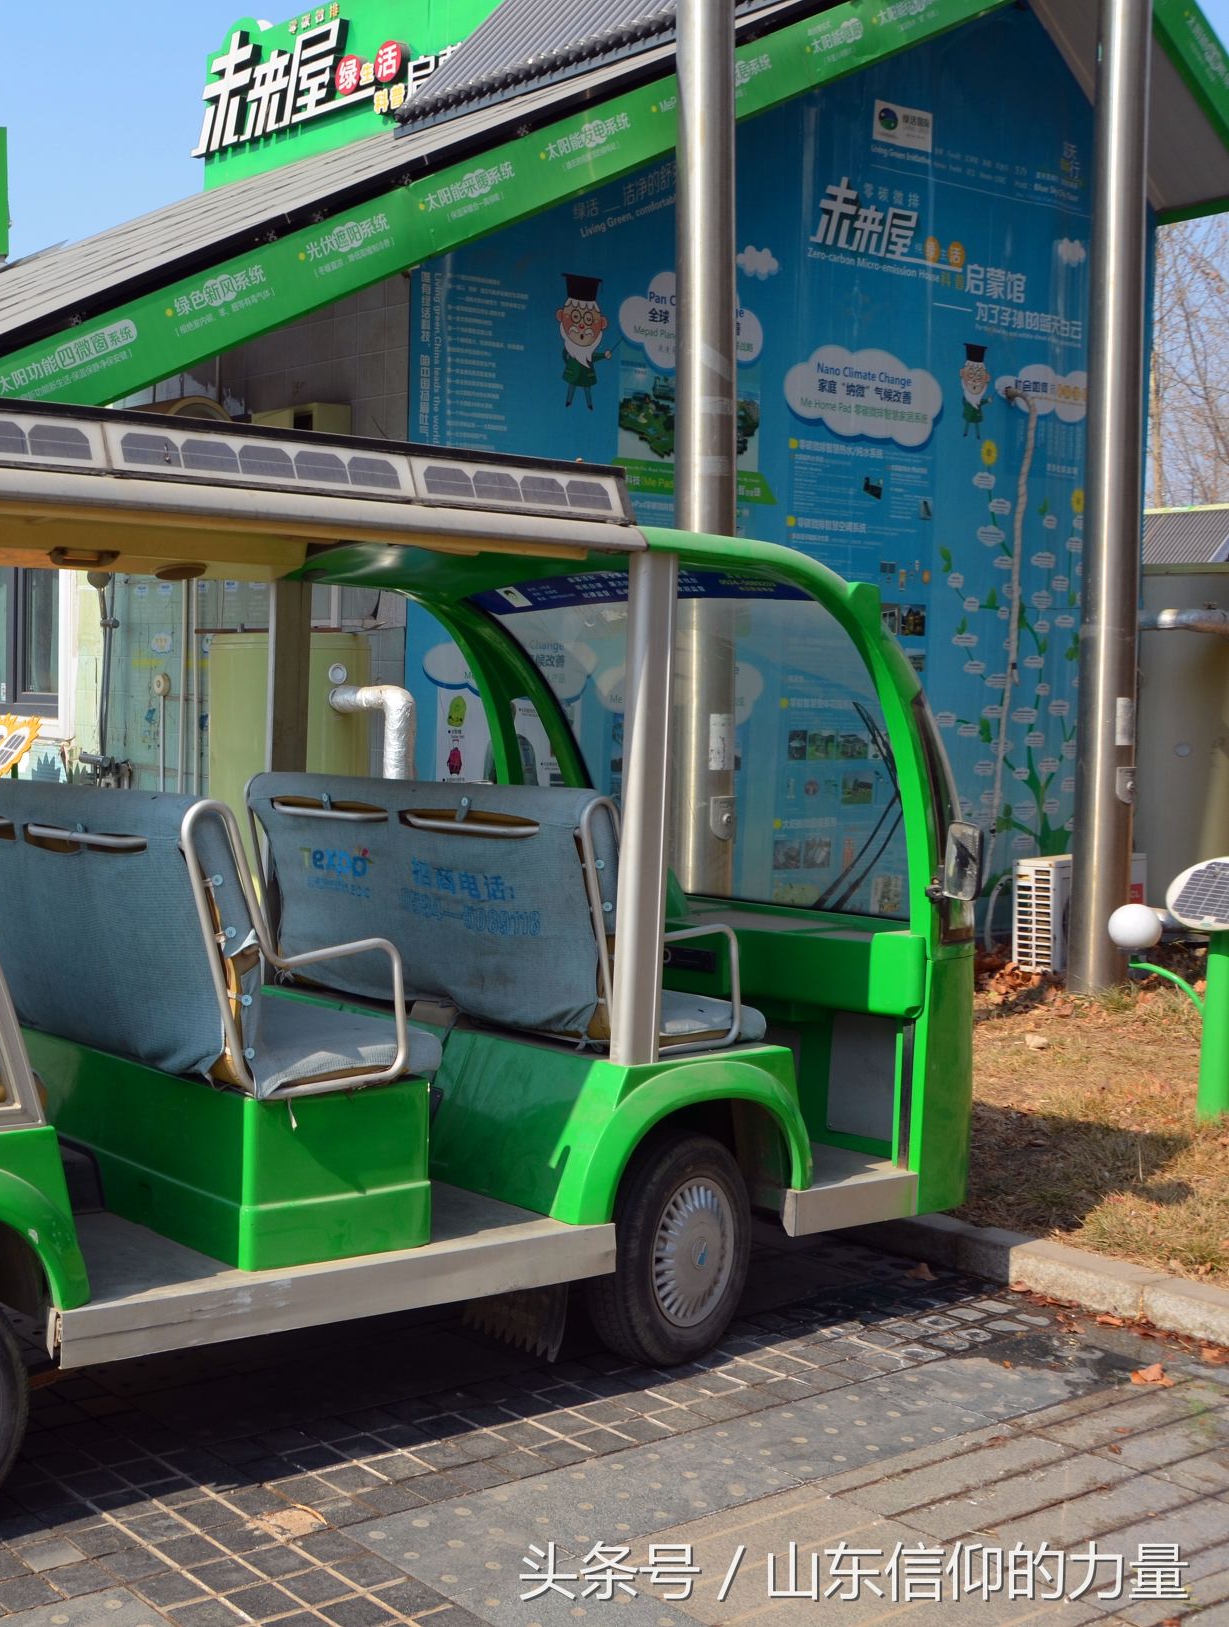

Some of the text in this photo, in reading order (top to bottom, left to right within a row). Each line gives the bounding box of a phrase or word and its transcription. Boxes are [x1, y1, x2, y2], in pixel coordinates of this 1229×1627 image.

[191, 18, 375, 158] 未来屋
[545, 112, 632, 161] 太阳能发电系统
[424, 161, 516, 213] 太阳能采暖系统
[305, 213, 391, 262] 光伏遮阳系统
[580, 219, 607, 238] Living
[809, 175, 963, 273] 未来屋
[807, 246, 856, 267] Zero-carbon
[857, 256, 917, 277] Micro-emission
[173, 264, 267, 317] 绿色新风系统
[433, 272, 443, 302] Living
[648, 291, 668, 306] Pan
[965, 263, 1027, 304] 启蒙馆
[647, 307, 670, 325] 全球
[974, 301, 1083, 340] 为了子孙的蓝天白云
[433, 336, 443, 365] China
[816, 361, 913, 389] Nano Climate Change
[433, 396, 441, 412] the
[817, 378, 838, 395] 家庭
[874, 386, 913, 406] 气候改善
